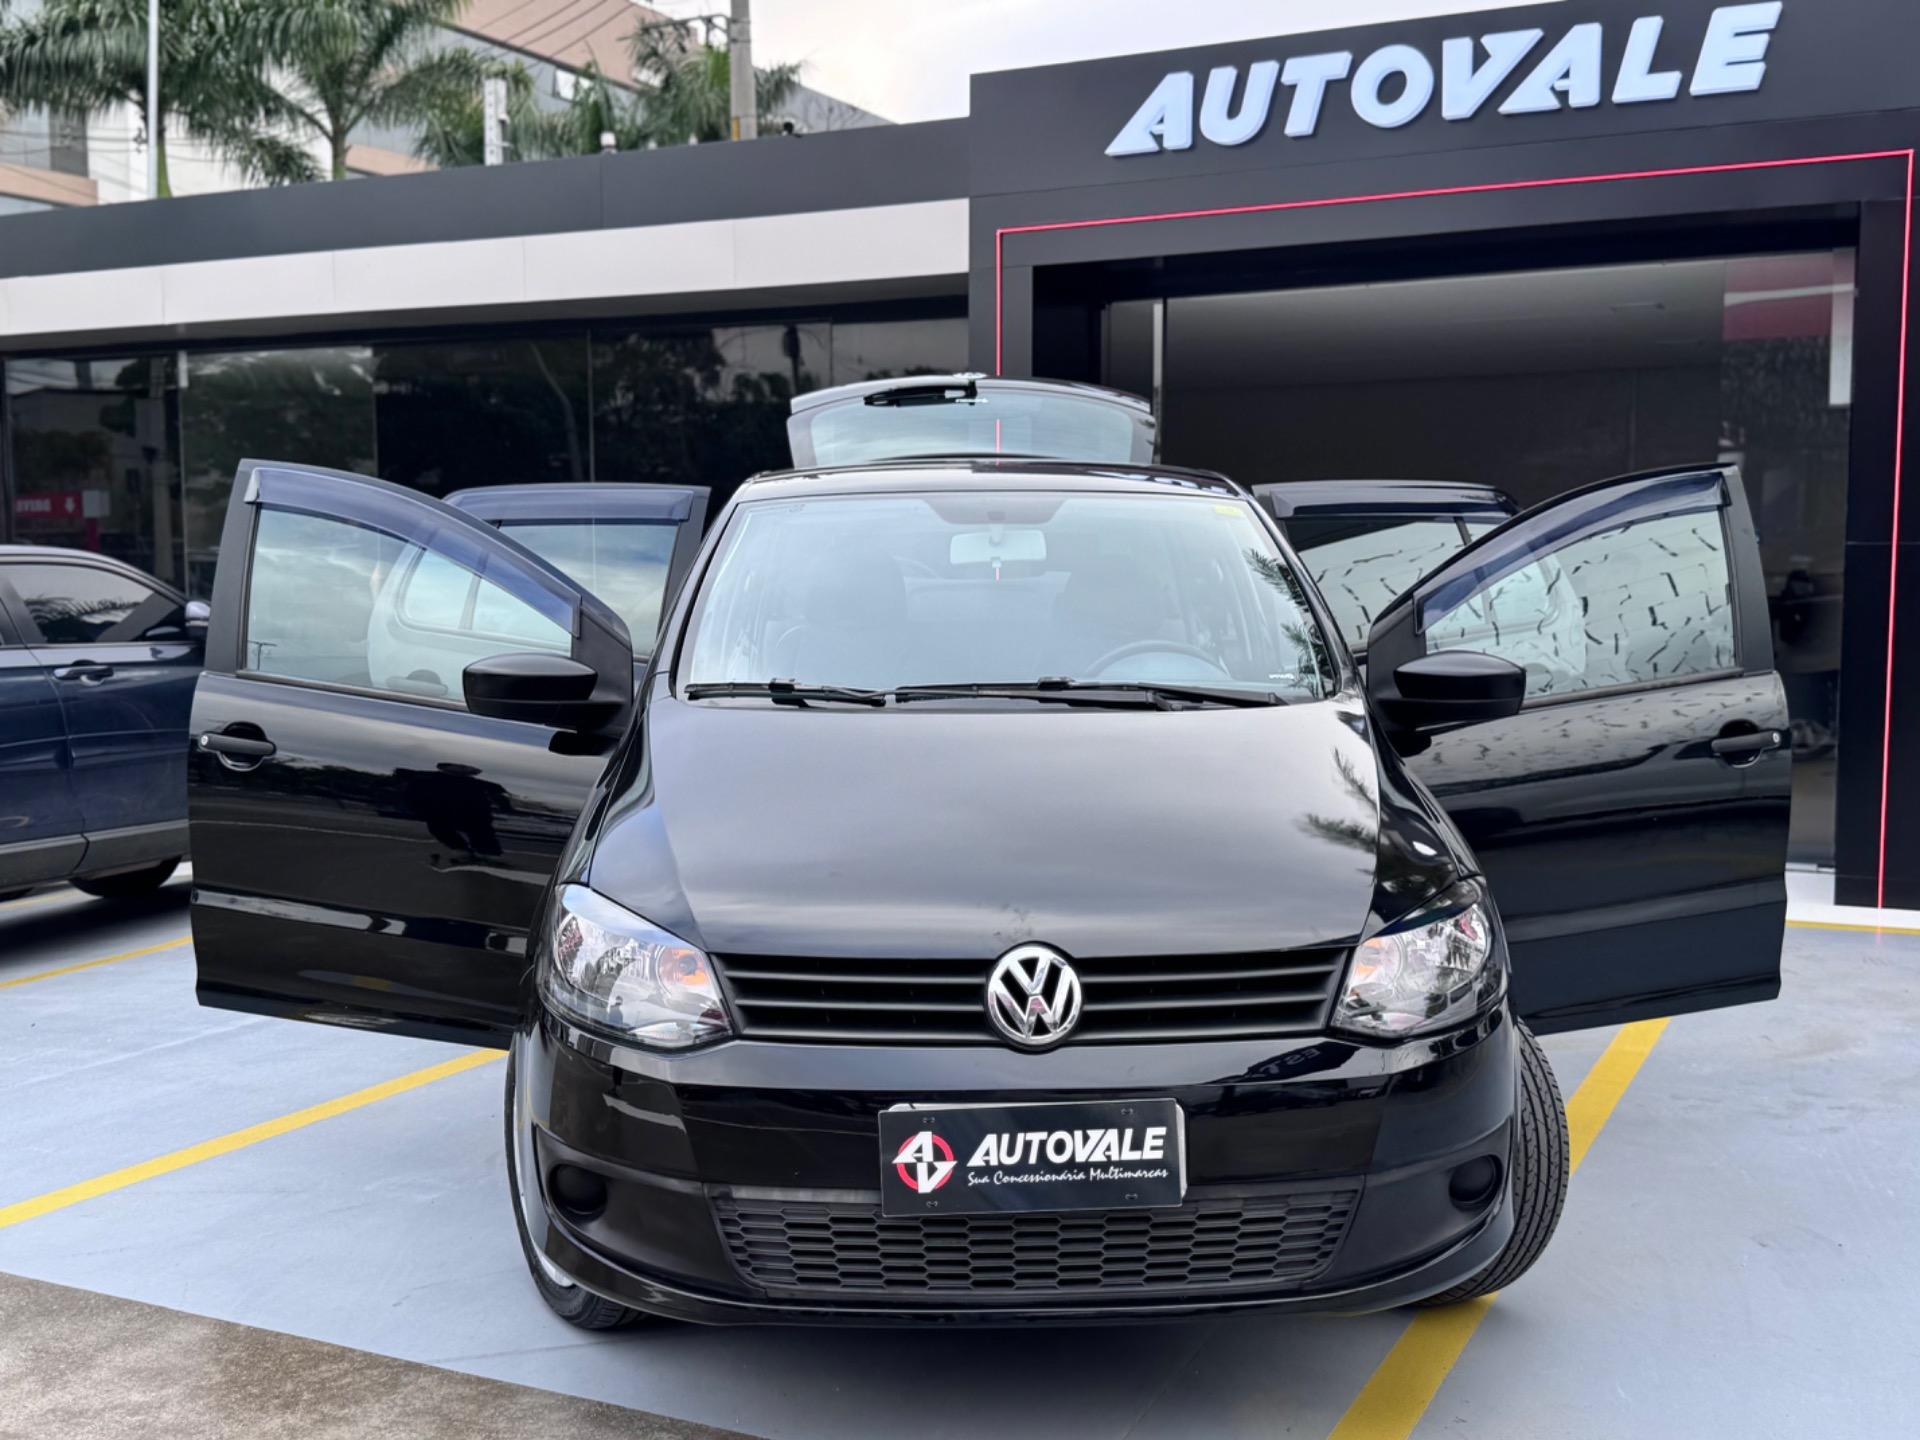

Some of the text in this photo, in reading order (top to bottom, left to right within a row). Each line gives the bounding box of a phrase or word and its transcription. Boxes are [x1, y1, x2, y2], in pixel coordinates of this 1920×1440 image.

[1105, 1, 1783, 157] AUTOVALE
[966, 1127, 1168, 1167] AUTOVALE
[968, 1165, 1168, 1187] Sua Concessionária Multimarcas
